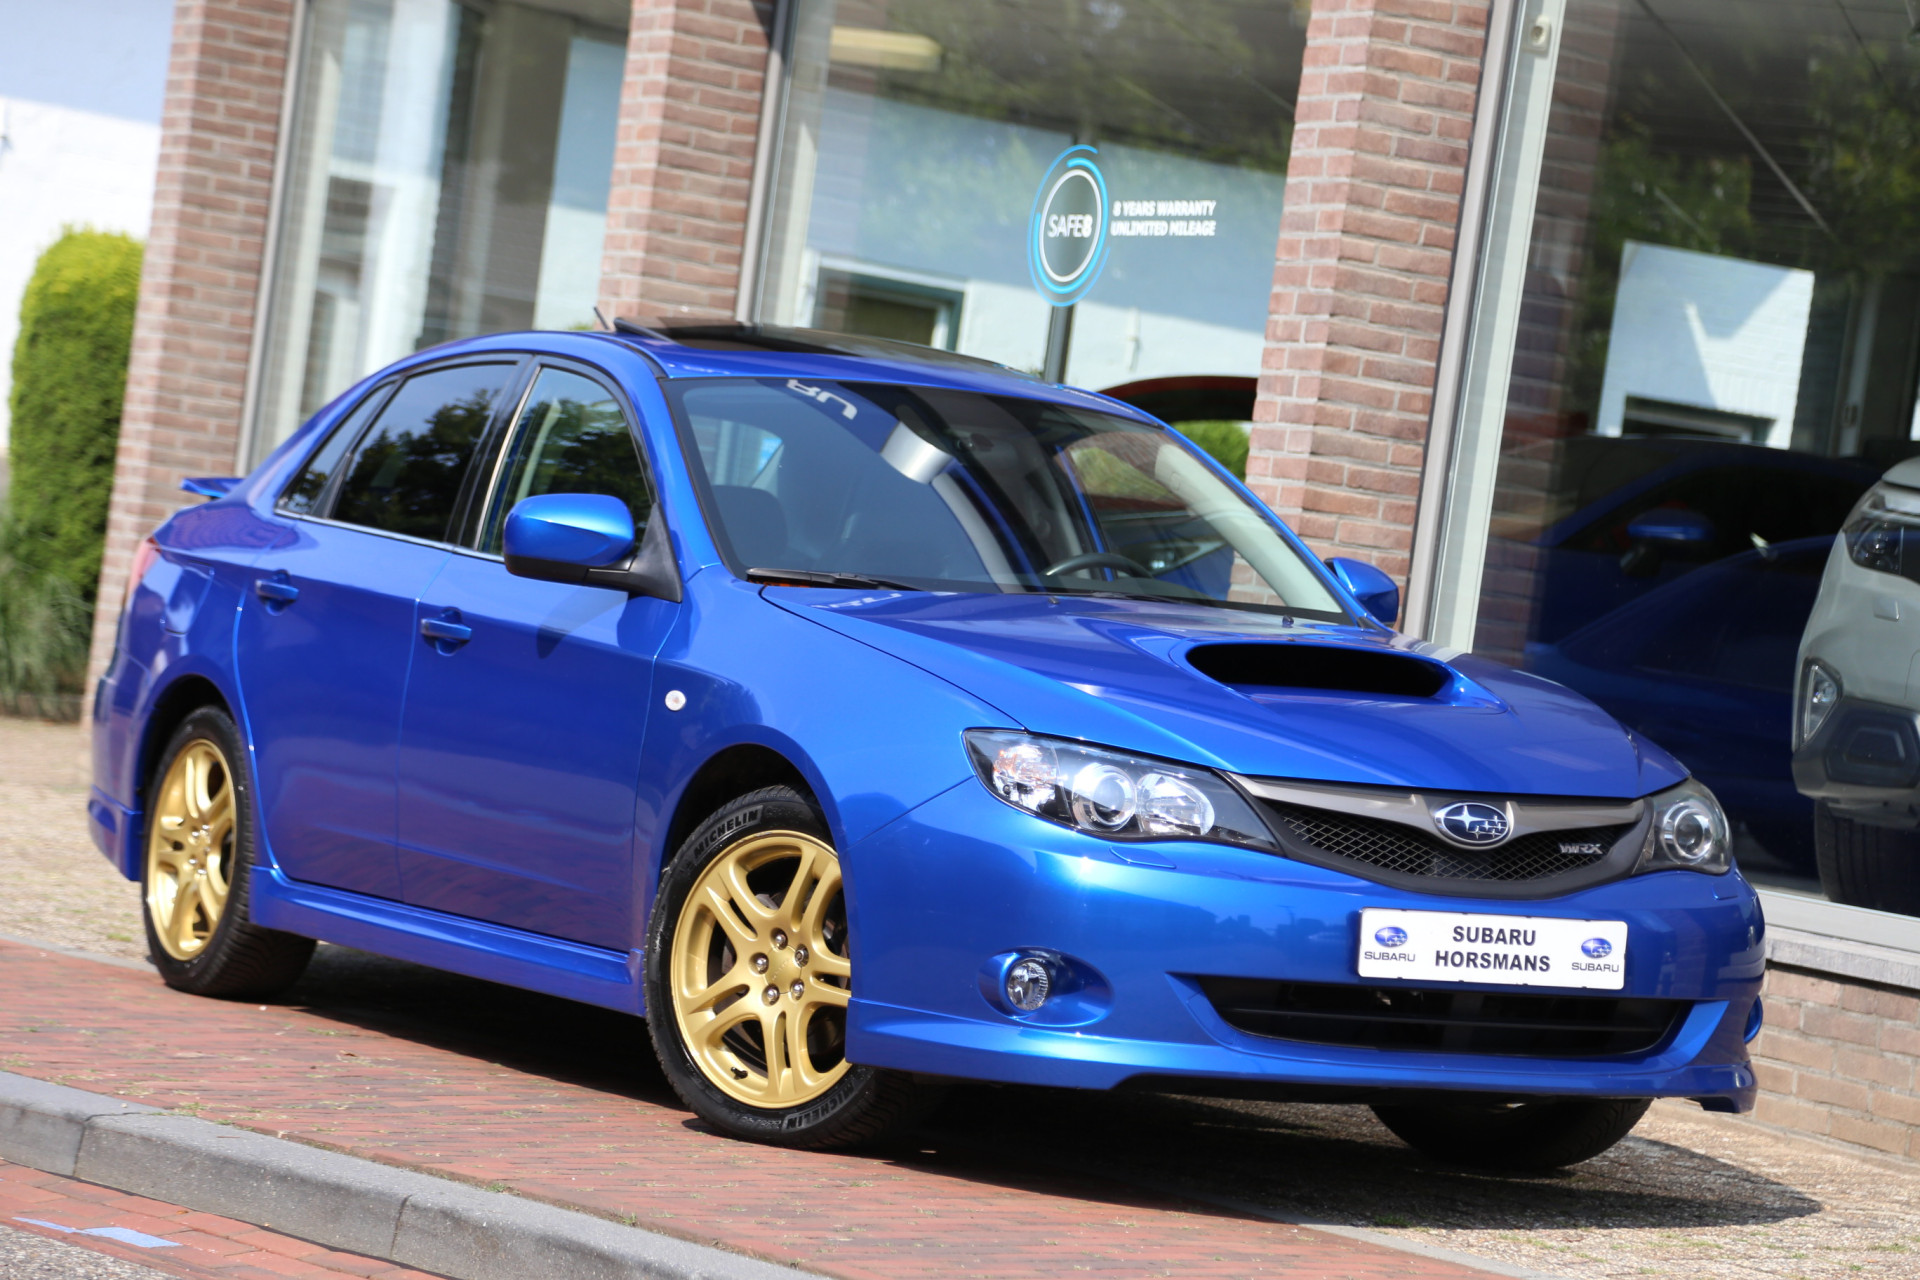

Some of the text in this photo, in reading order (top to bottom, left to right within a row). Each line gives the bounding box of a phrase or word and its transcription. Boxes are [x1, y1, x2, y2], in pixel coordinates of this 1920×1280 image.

[1113, 201, 1216, 216] 8 YEARS WARRANTY
[1048, 214, 1093, 237] SAFE8
[1110, 221, 1216, 236] UNLIMITED MILEAGE
[694, 810, 759, 858] MICHELIN
[1559, 843, 1603, 854] WRX
[1453, 925, 1536, 946] SUBARU
[1364, 951, 1416, 962] SUBARU
[1434, 950, 1550, 972] HORSMANS
[1571, 962, 1620, 973] SUBARU
